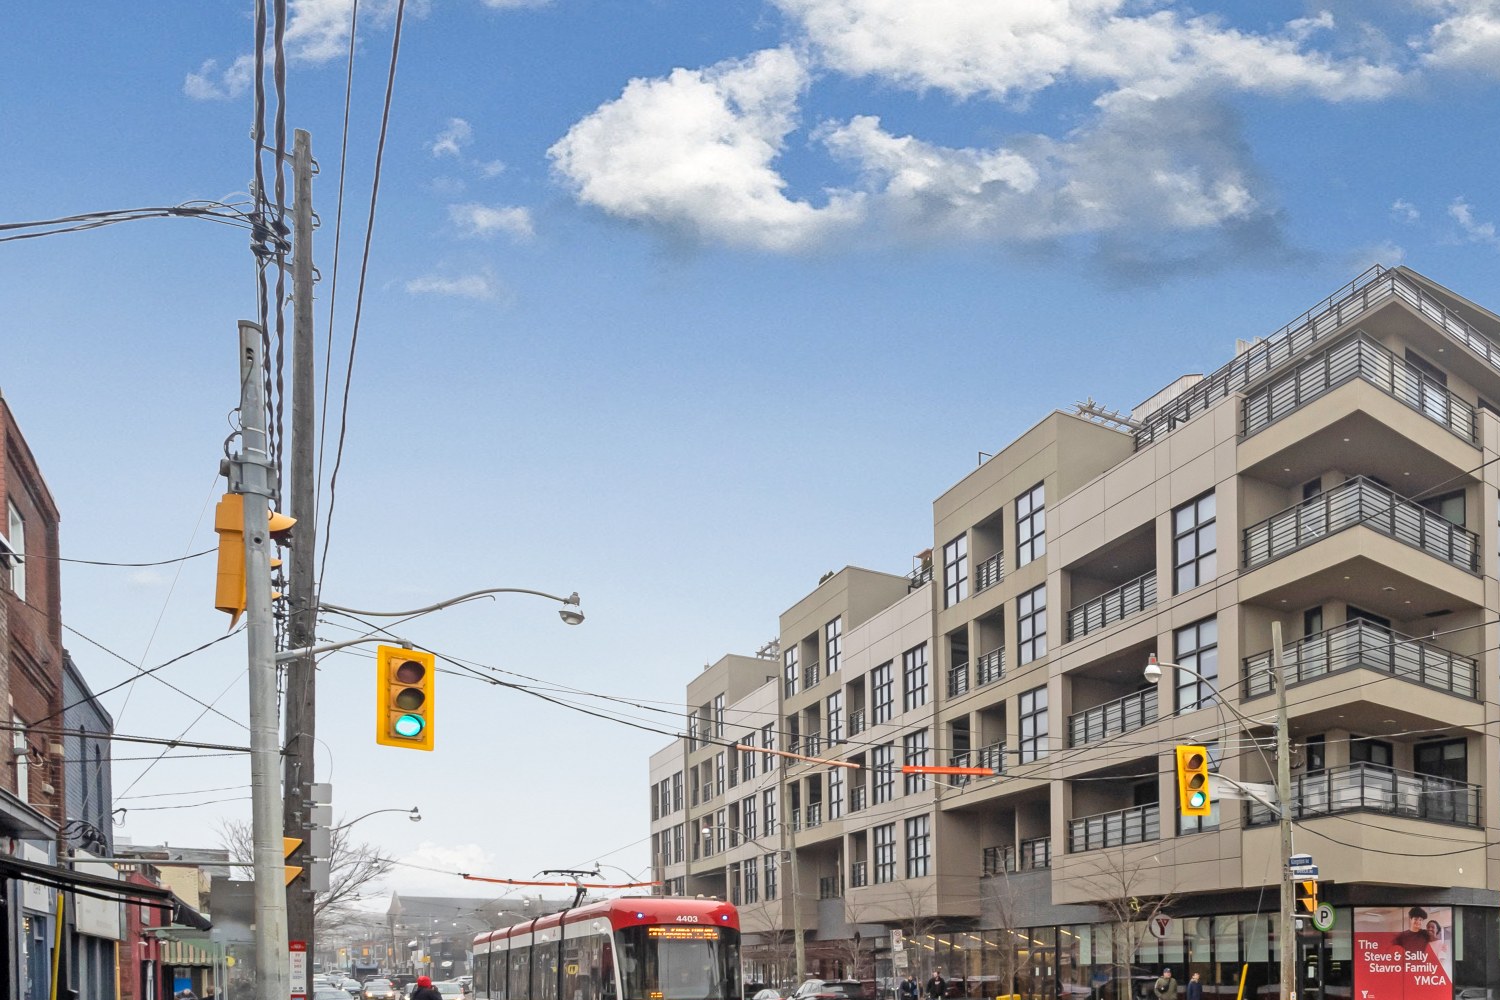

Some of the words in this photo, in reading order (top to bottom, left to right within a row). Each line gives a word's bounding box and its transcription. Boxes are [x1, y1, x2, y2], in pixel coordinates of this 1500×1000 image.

[1320, 910, 1329, 923] P
[1358, 939, 1379, 950] The
[1364, 951, 1392, 961] Steve
[1393, 951, 1402, 961] &
[1404, 950, 1429, 963] Sally
[1369, 962, 1402, 973] Stavro
[1405, 962, 1438, 975] Family
[1414, 975, 1447, 986] YMCA
